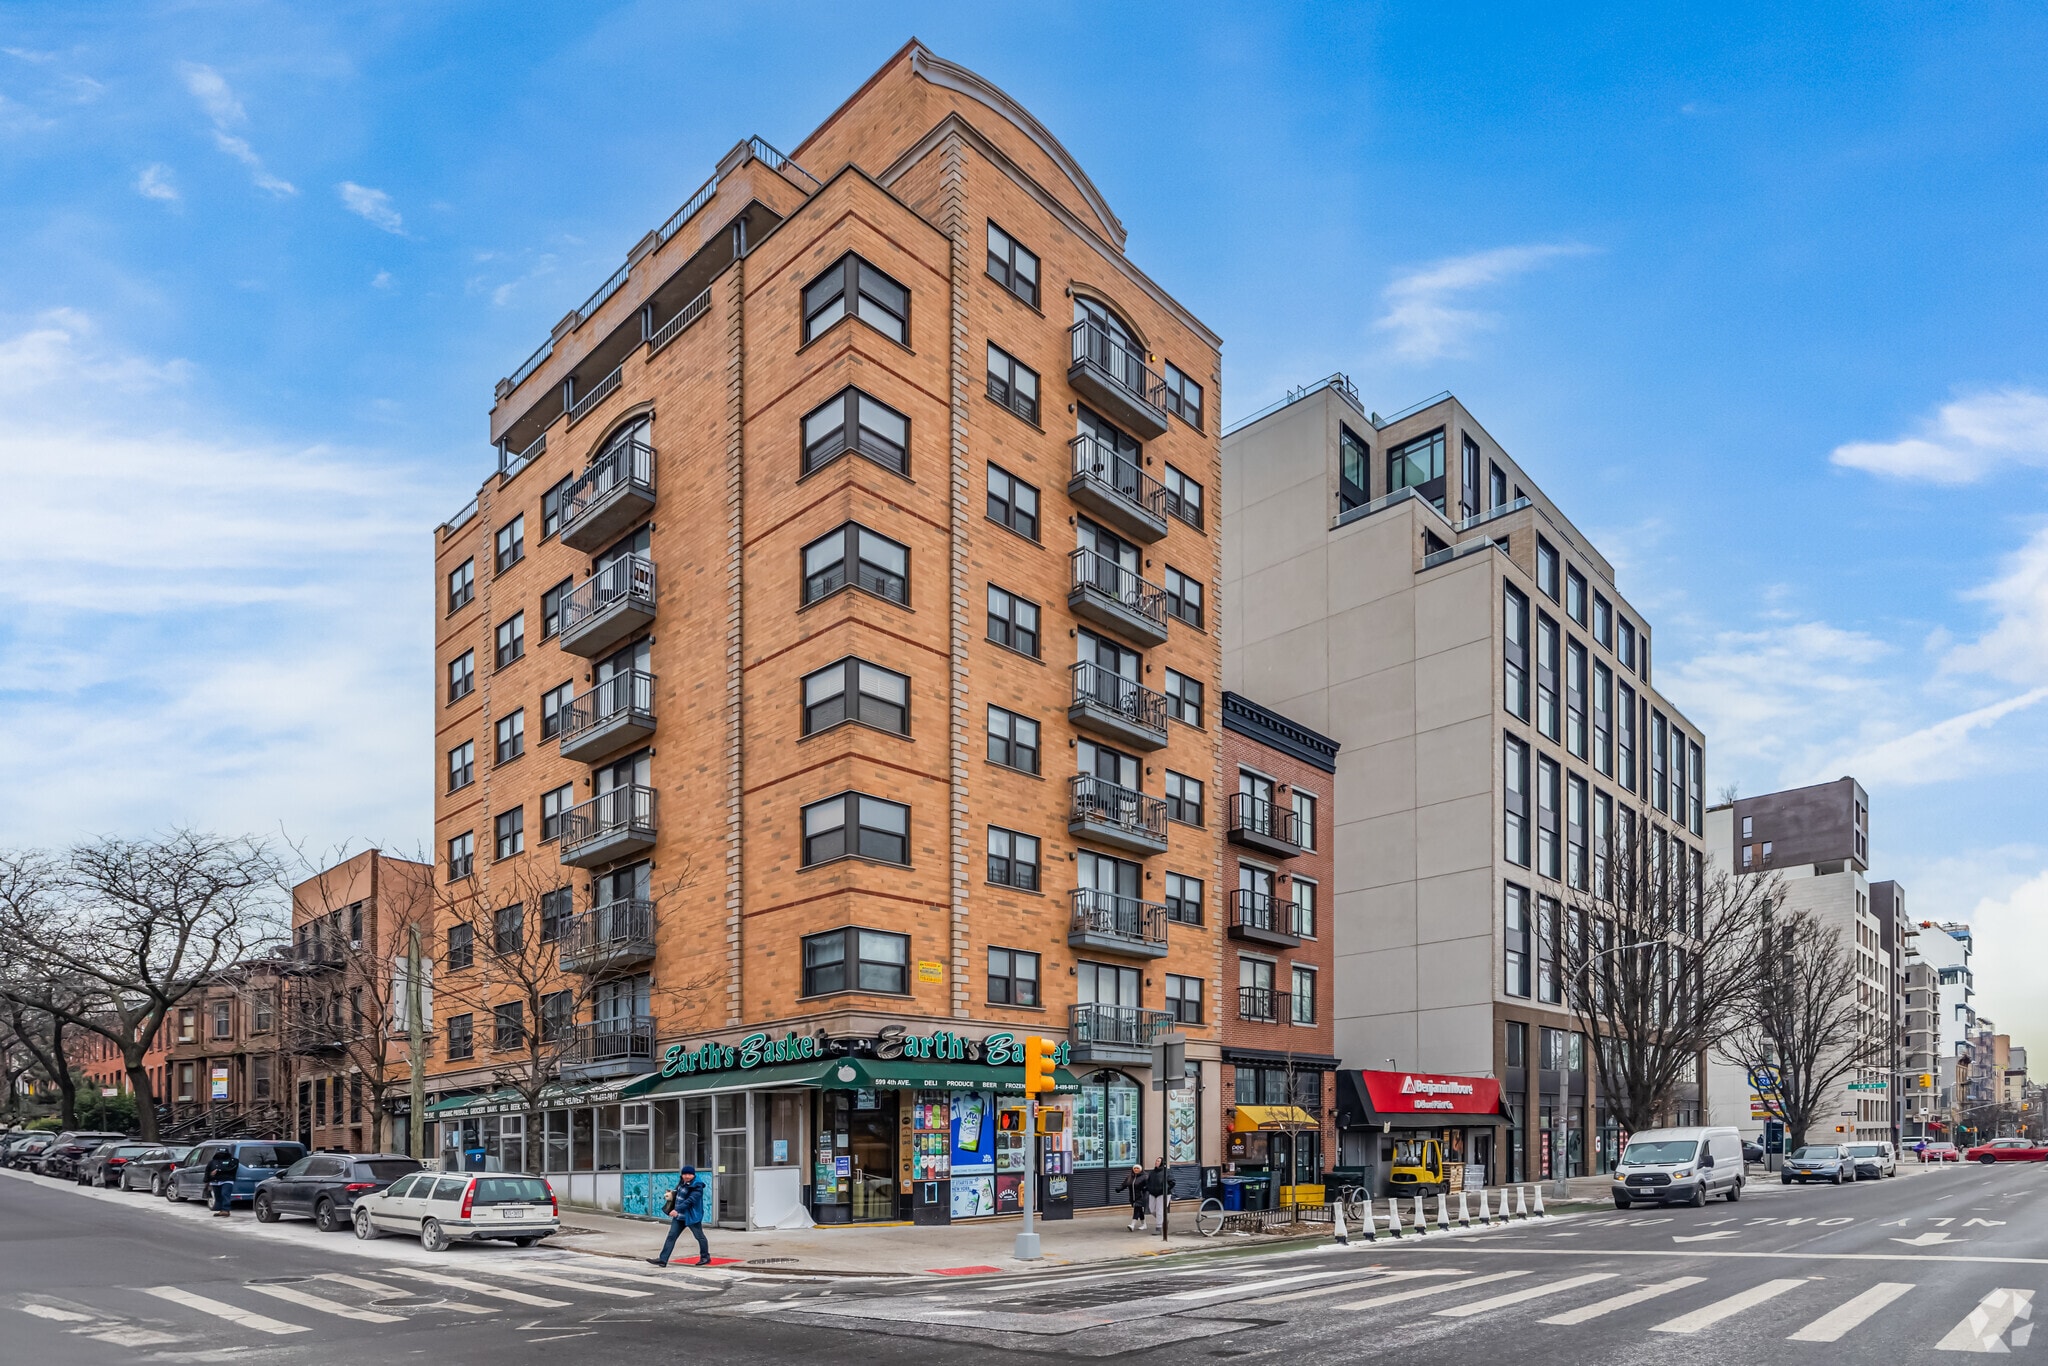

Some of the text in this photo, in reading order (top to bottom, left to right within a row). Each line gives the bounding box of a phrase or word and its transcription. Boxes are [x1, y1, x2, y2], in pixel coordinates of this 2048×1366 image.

[877, 1025, 1071, 1066] Earth's Baet
[662, 1042, 734, 1077] Earth's
[947, 1080, 975, 1088] PRODUCE
[966, 1111, 978, 1120] VITA
